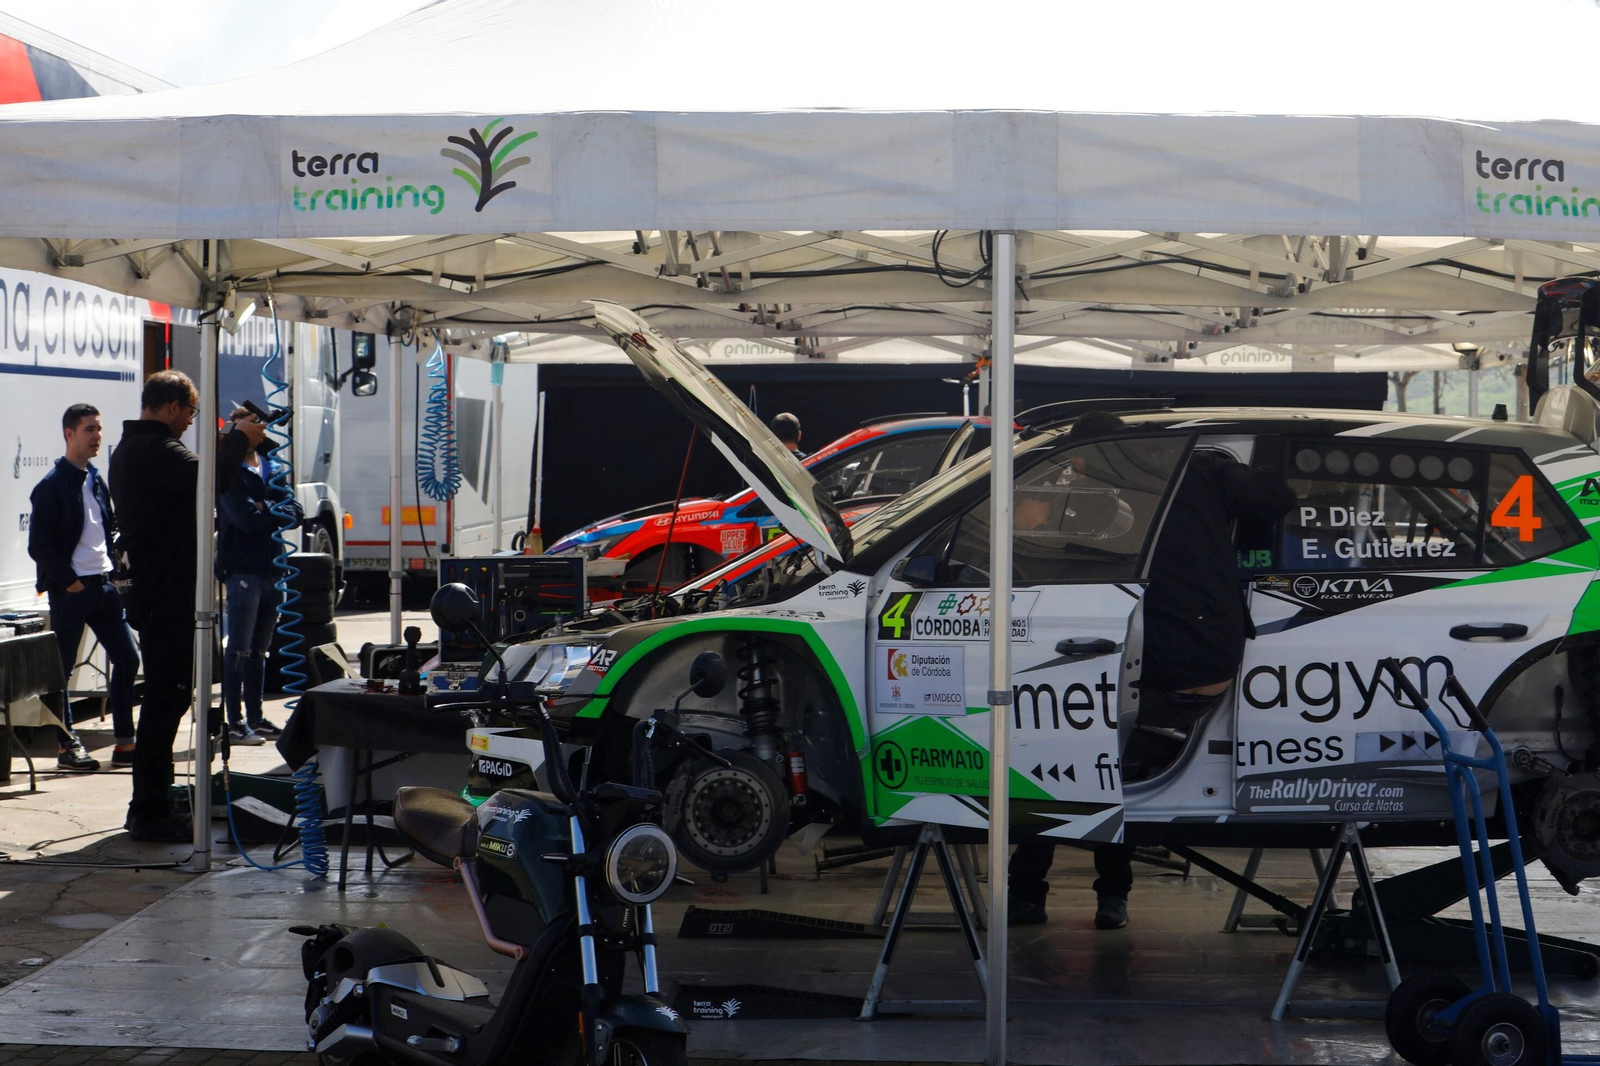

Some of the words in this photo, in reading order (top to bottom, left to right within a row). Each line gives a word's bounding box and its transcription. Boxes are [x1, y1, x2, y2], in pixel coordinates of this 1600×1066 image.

[292, 150, 378, 177] terra
[1476, 150, 1564, 182] terra
[293, 175, 445, 215] training
[1476, 184, 1600, 217] trainin
[673, 510, 719, 523] HYUNDAI
[1300, 507, 1321, 527] P.
[1330, 506, 1386, 527] Diez
[1490, 474, 1542, 542] 4
[721, 530, 746, 541] UPPER
[723, 540, 743, 550] CLUB
[1302, 539, 1327, 559] E.
[1334, 537, 1456, 558] Gutierrez
[818, 588, 849, 597] training
[1320, 578, 1393, 593] KTVA
[882, 593, 912, 638] 4
[916, 616, 980, 637] CÓRDOBA
[911, 655, 950, 666] Diputación
[911, 667, 920, 677] de
[921, 666, 951, 677] Córdoba
[932, 693, 962, 703] IMDECO
[1013, 671, 1117, 730] met
[911, 747, 984, 771] FARMA10
[915, 776, 924, 785] TU
[925, 776, 954, 787] ESPACIO
[955, 779, 965, 787] DE
[966, 780, 990, 788] SALUD
[1250, 777, 1404, 804] TheRallyDriver.com
[1334, 799, 1360, 812] Curso
[1362, 800, 1374, 811] de
[1376, 800, 1404, 811] Notas
[709, 923, 734, 933] GT2i
[693, 1006, 724, 1015] training
